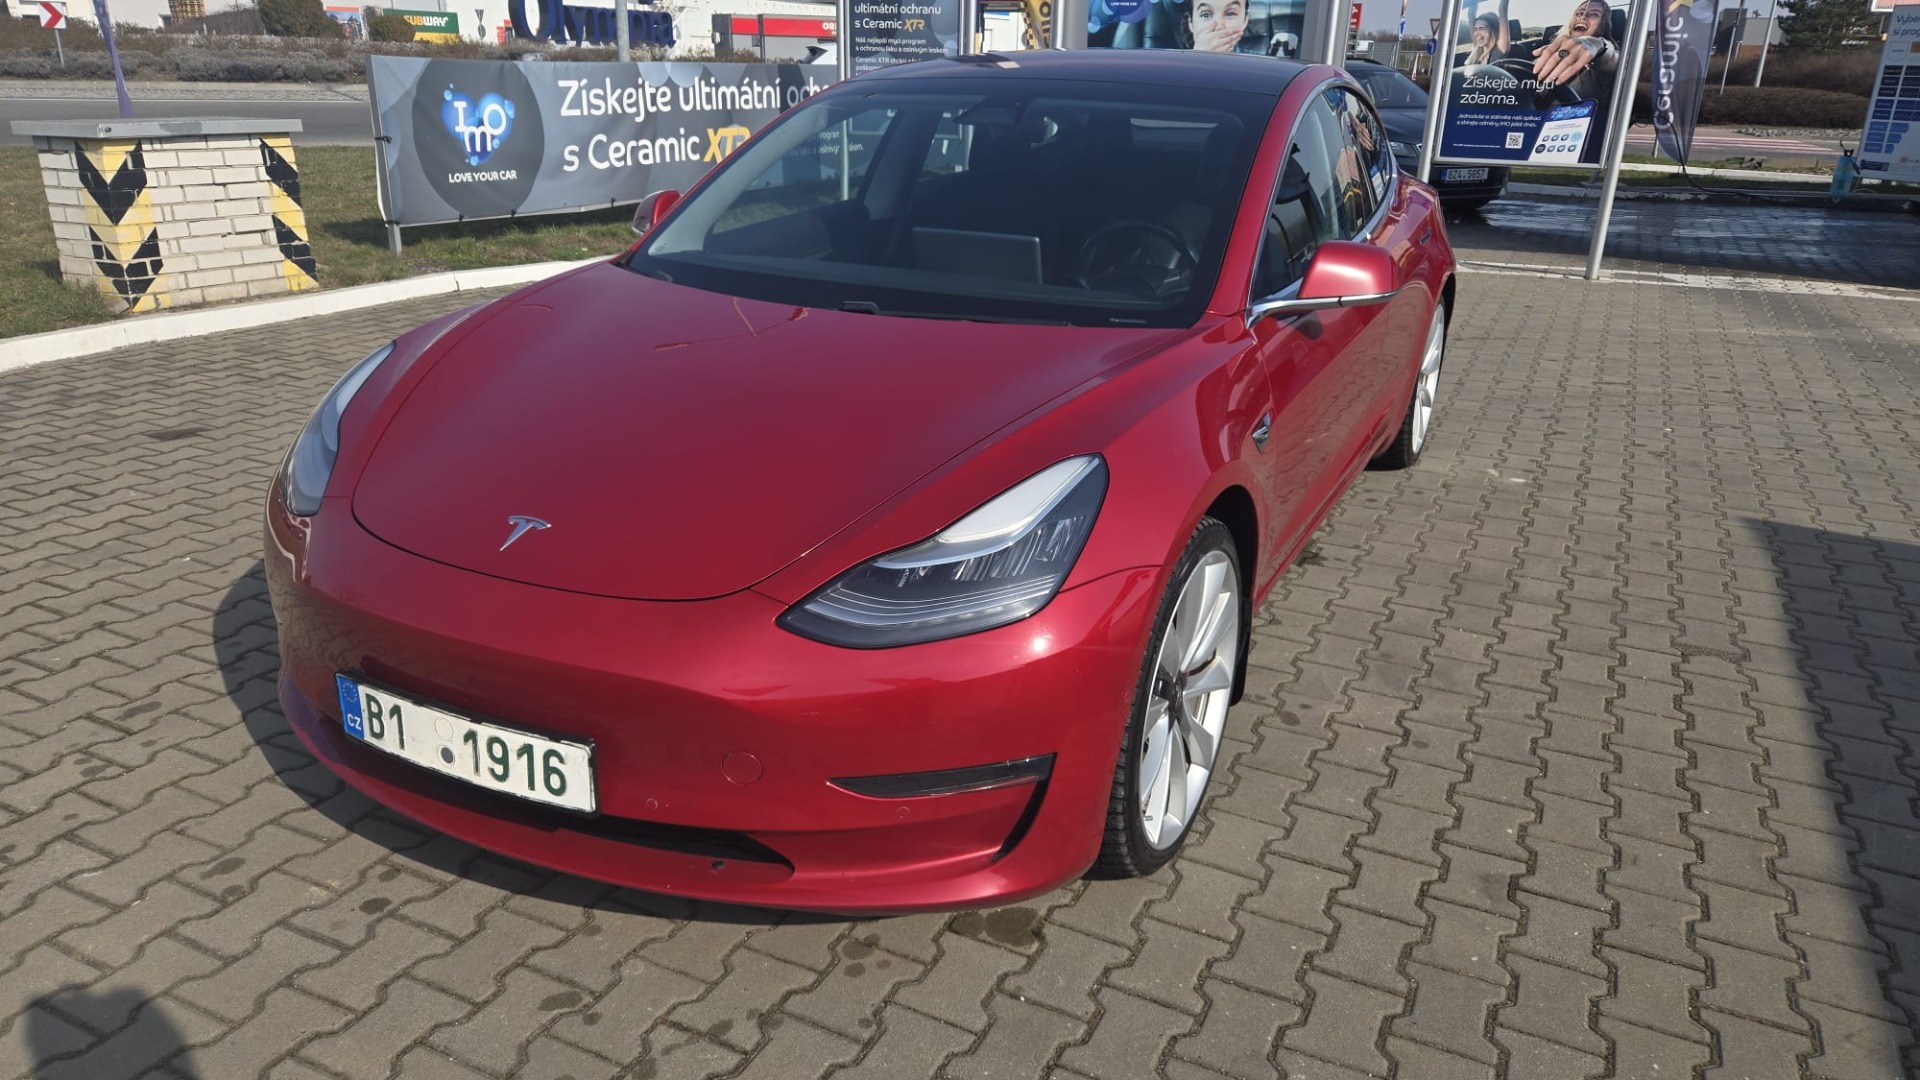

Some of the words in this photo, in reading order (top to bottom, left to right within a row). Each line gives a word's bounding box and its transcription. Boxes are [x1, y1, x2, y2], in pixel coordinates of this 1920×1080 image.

[854, 3, 898, 14] ultimátní
[899, 4, 942, 14] ochranu
[862, 18, 902, 29] Ceramic
[903, 19, 925, 32] XTR
[1462, 75, 1517, 91] Získejte
[557, 77, 672, 123] Získejte
[679, 76, 781, 112] ultimátní
[1459, 91, 1519, 105] zdarma.
[563, 145, 580, 172] s
[588, 127, 701, 169] Ceramic
[448, 173, 473, 183] LOVE
[473, 171, 499, 182] YOUR
[500, 170, 517, 180] CAR
[347, 713, 361, 730] CZ
[365, 692, 405, 750] B1
[463, 728, 567, 797] 1916
